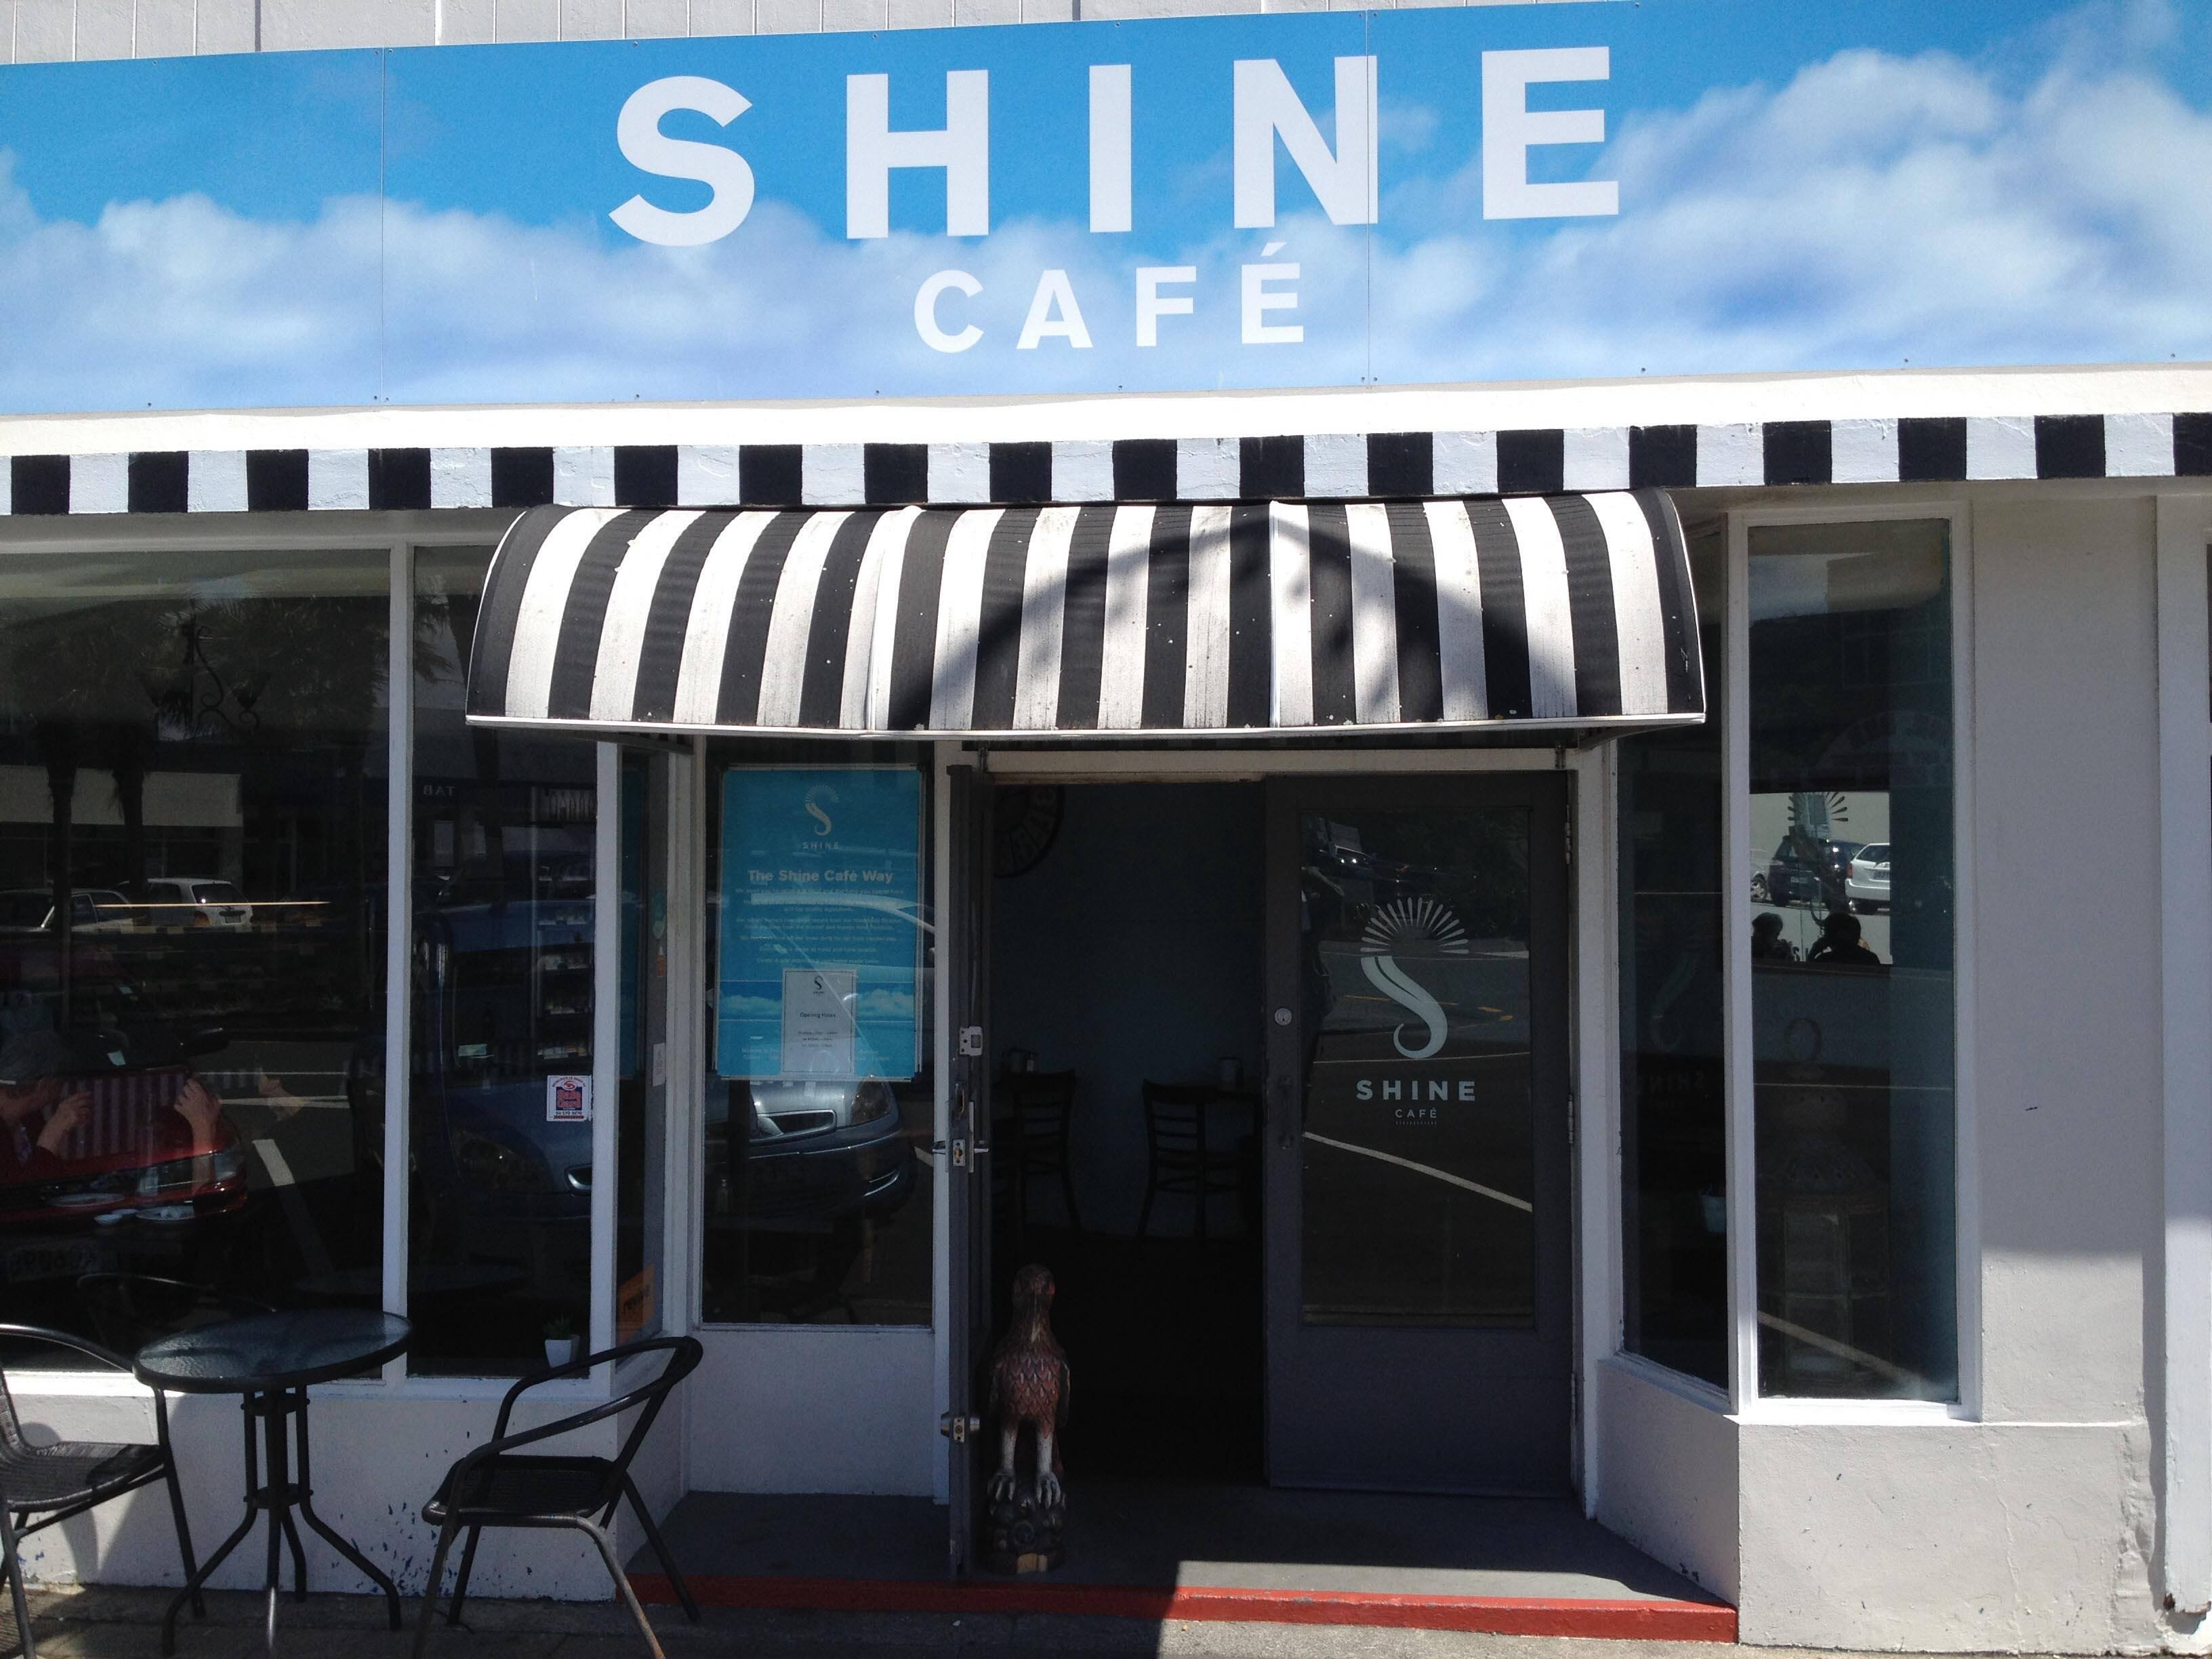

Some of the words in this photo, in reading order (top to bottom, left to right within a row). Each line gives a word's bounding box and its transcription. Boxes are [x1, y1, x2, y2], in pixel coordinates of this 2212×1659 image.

[608, 46, 1619, 247] SHINE
[914, 242, 1304, 353] CAFÉ
[802, 842, 840, 850] SHINE
[747, 870, 774, 881] The
[779, 870, 819, 882] Shine
[862, 870, 893, 884] Way
[1355, 1080, 1476, 1101] SHINE
[1394, 1107, 1437, 1118] CAFÉ
